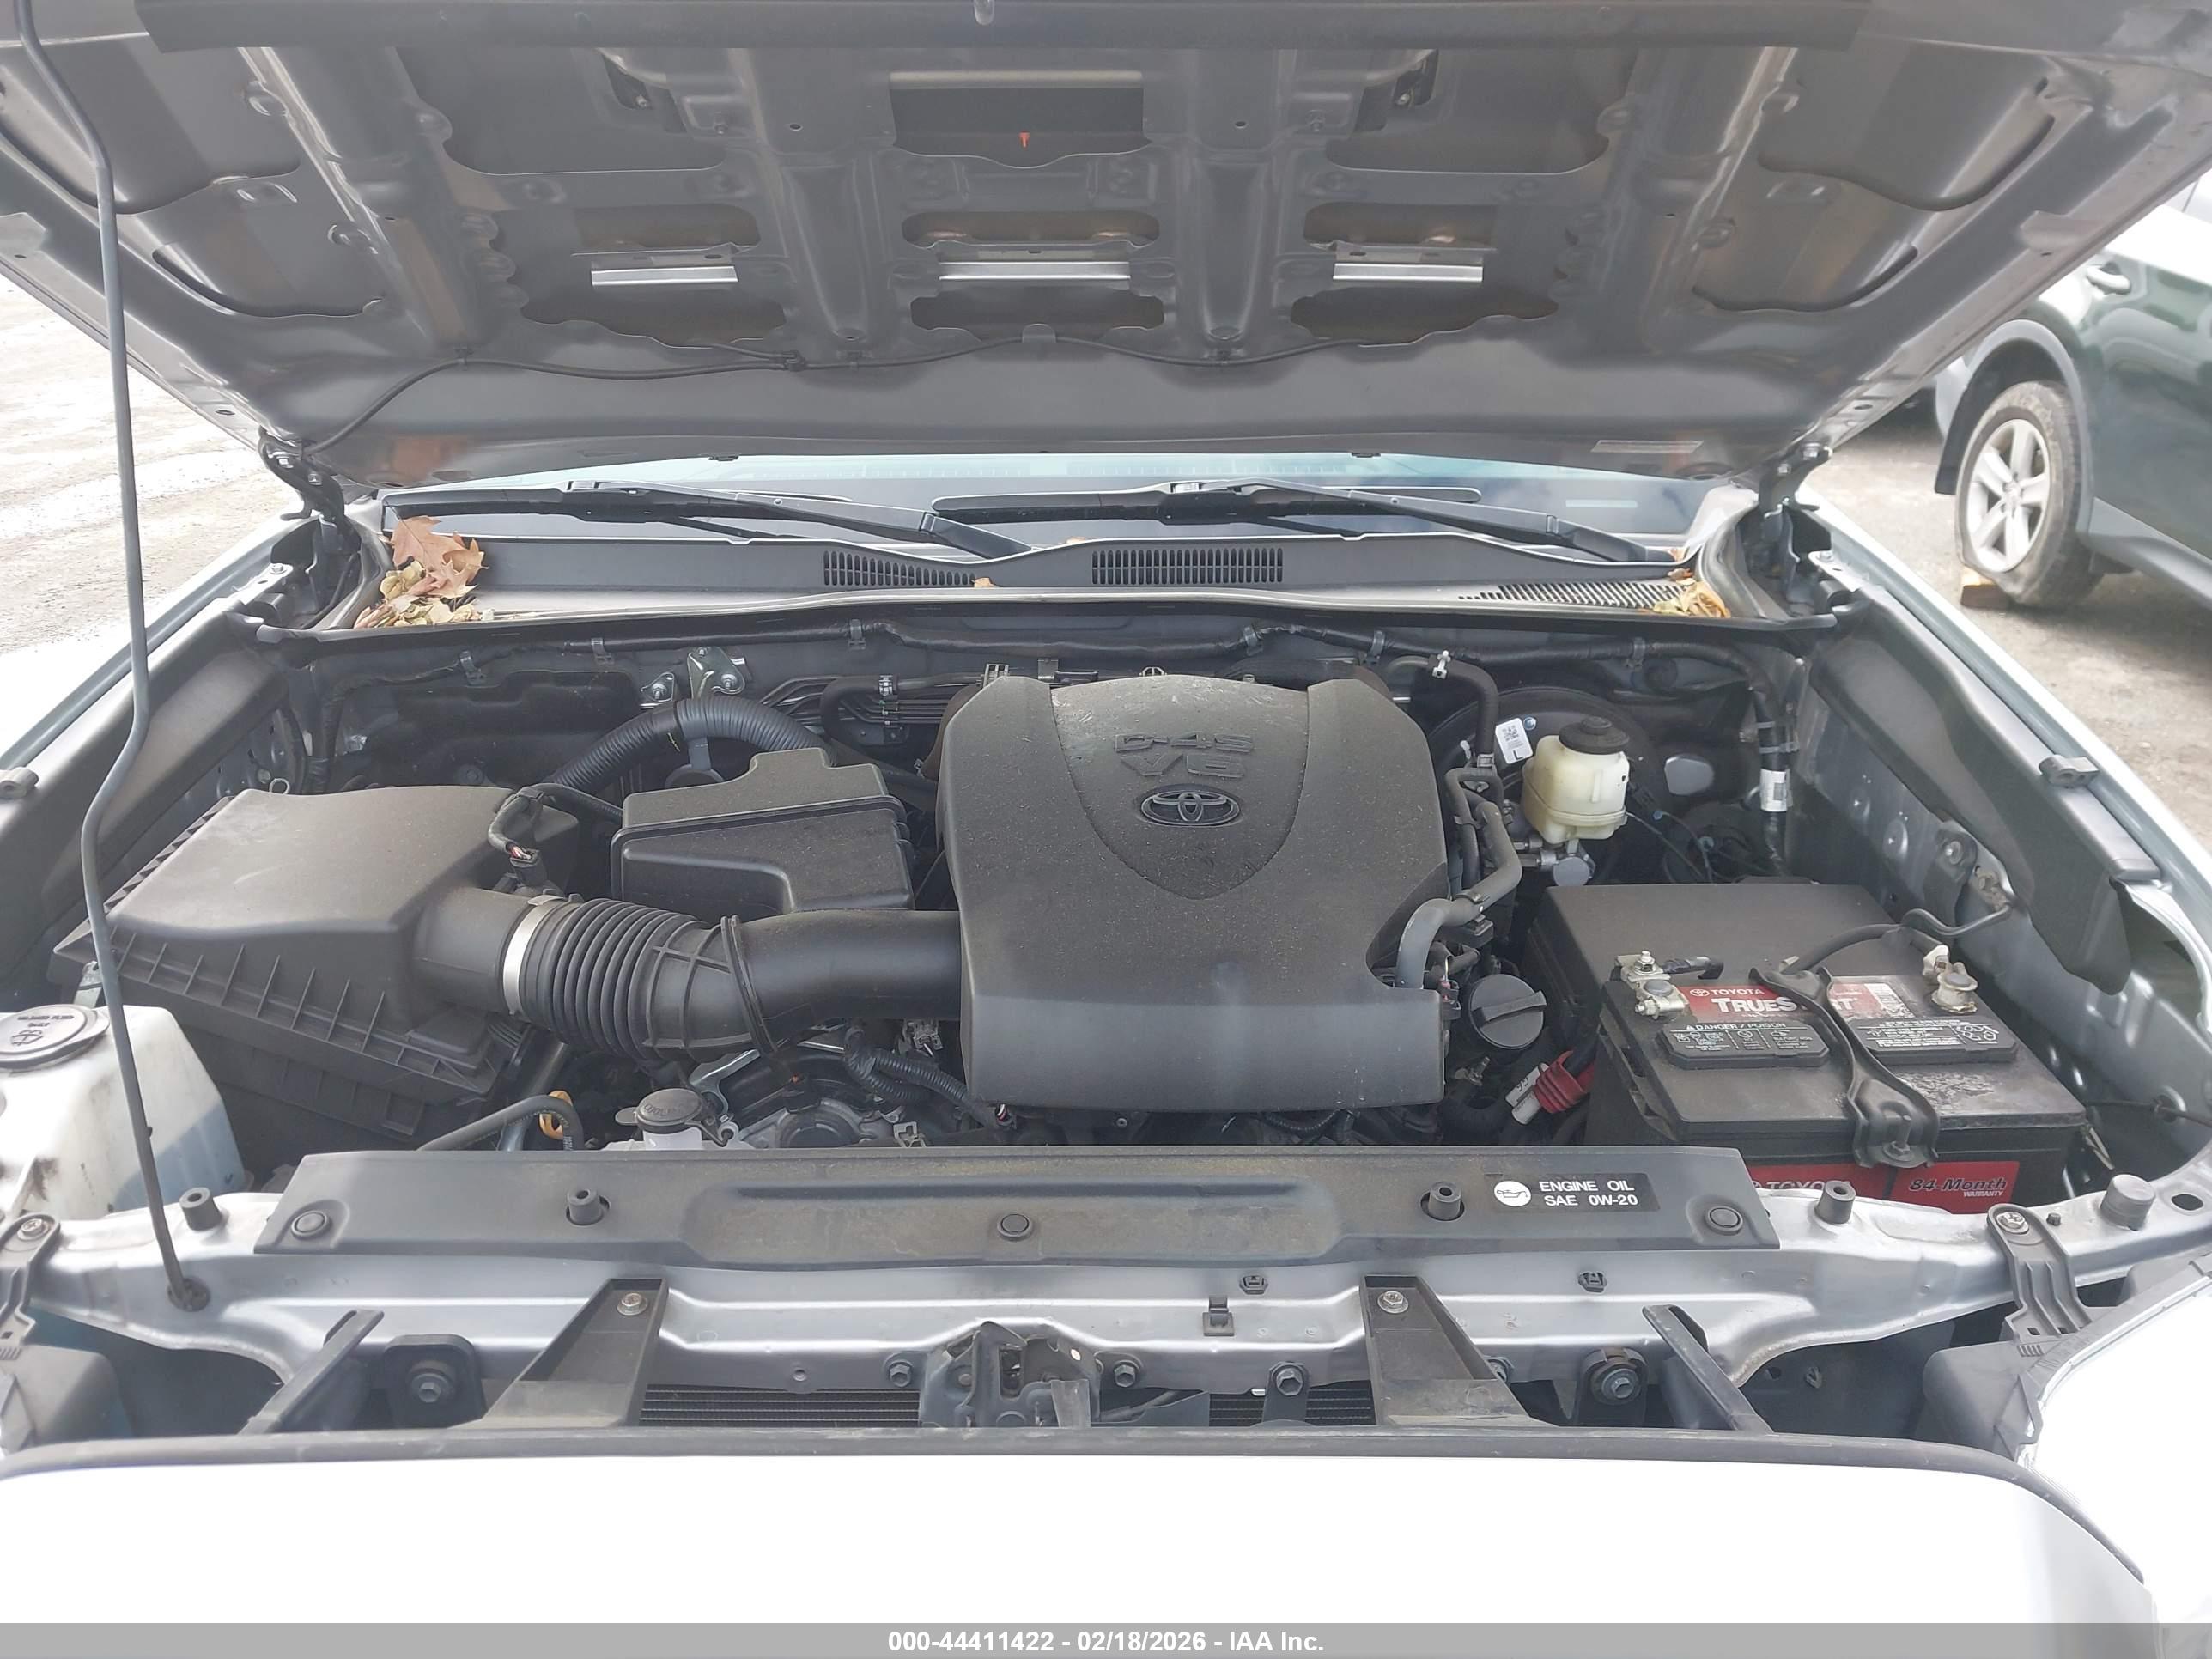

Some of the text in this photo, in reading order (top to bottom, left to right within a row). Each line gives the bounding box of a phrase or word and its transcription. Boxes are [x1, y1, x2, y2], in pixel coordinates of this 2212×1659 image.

[1115, 732, 1255, 753] D-4S
[1120, 752, 1247, 778] V6
[1539, 1180, 1634, 1192] ENGINE OIL
[1909, 1177, 2007, 1193] 84-Month
[1544, 1194, 1638, 1206] SAE 0W-20
